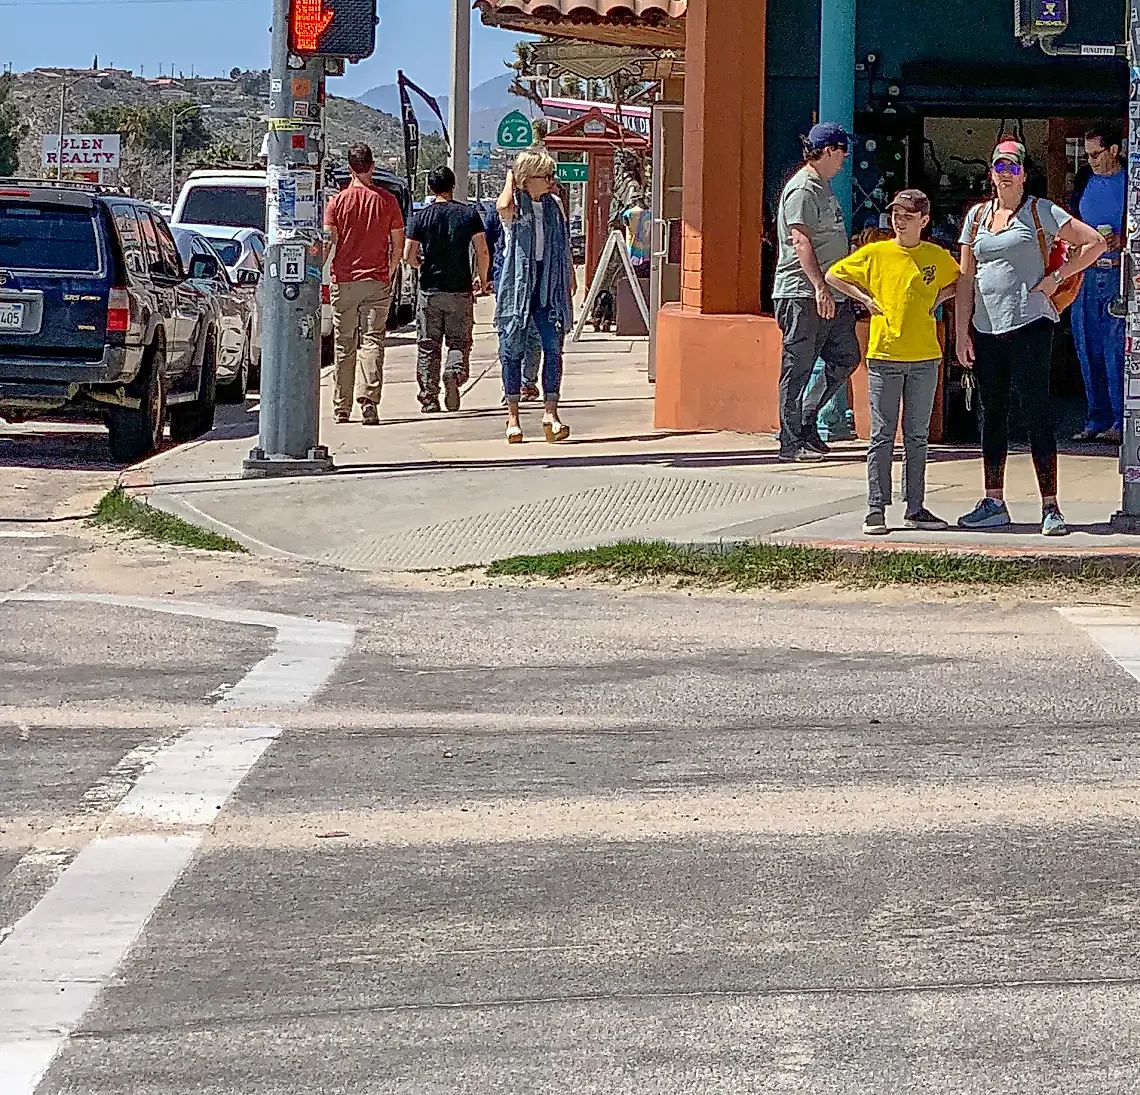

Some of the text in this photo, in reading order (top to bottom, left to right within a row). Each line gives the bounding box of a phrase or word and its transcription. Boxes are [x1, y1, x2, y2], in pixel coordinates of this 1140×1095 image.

[501, 126, 528, 143] 62
[46, 152, 116, 164] REALTY
[572, 168, 586, 177] Tr
